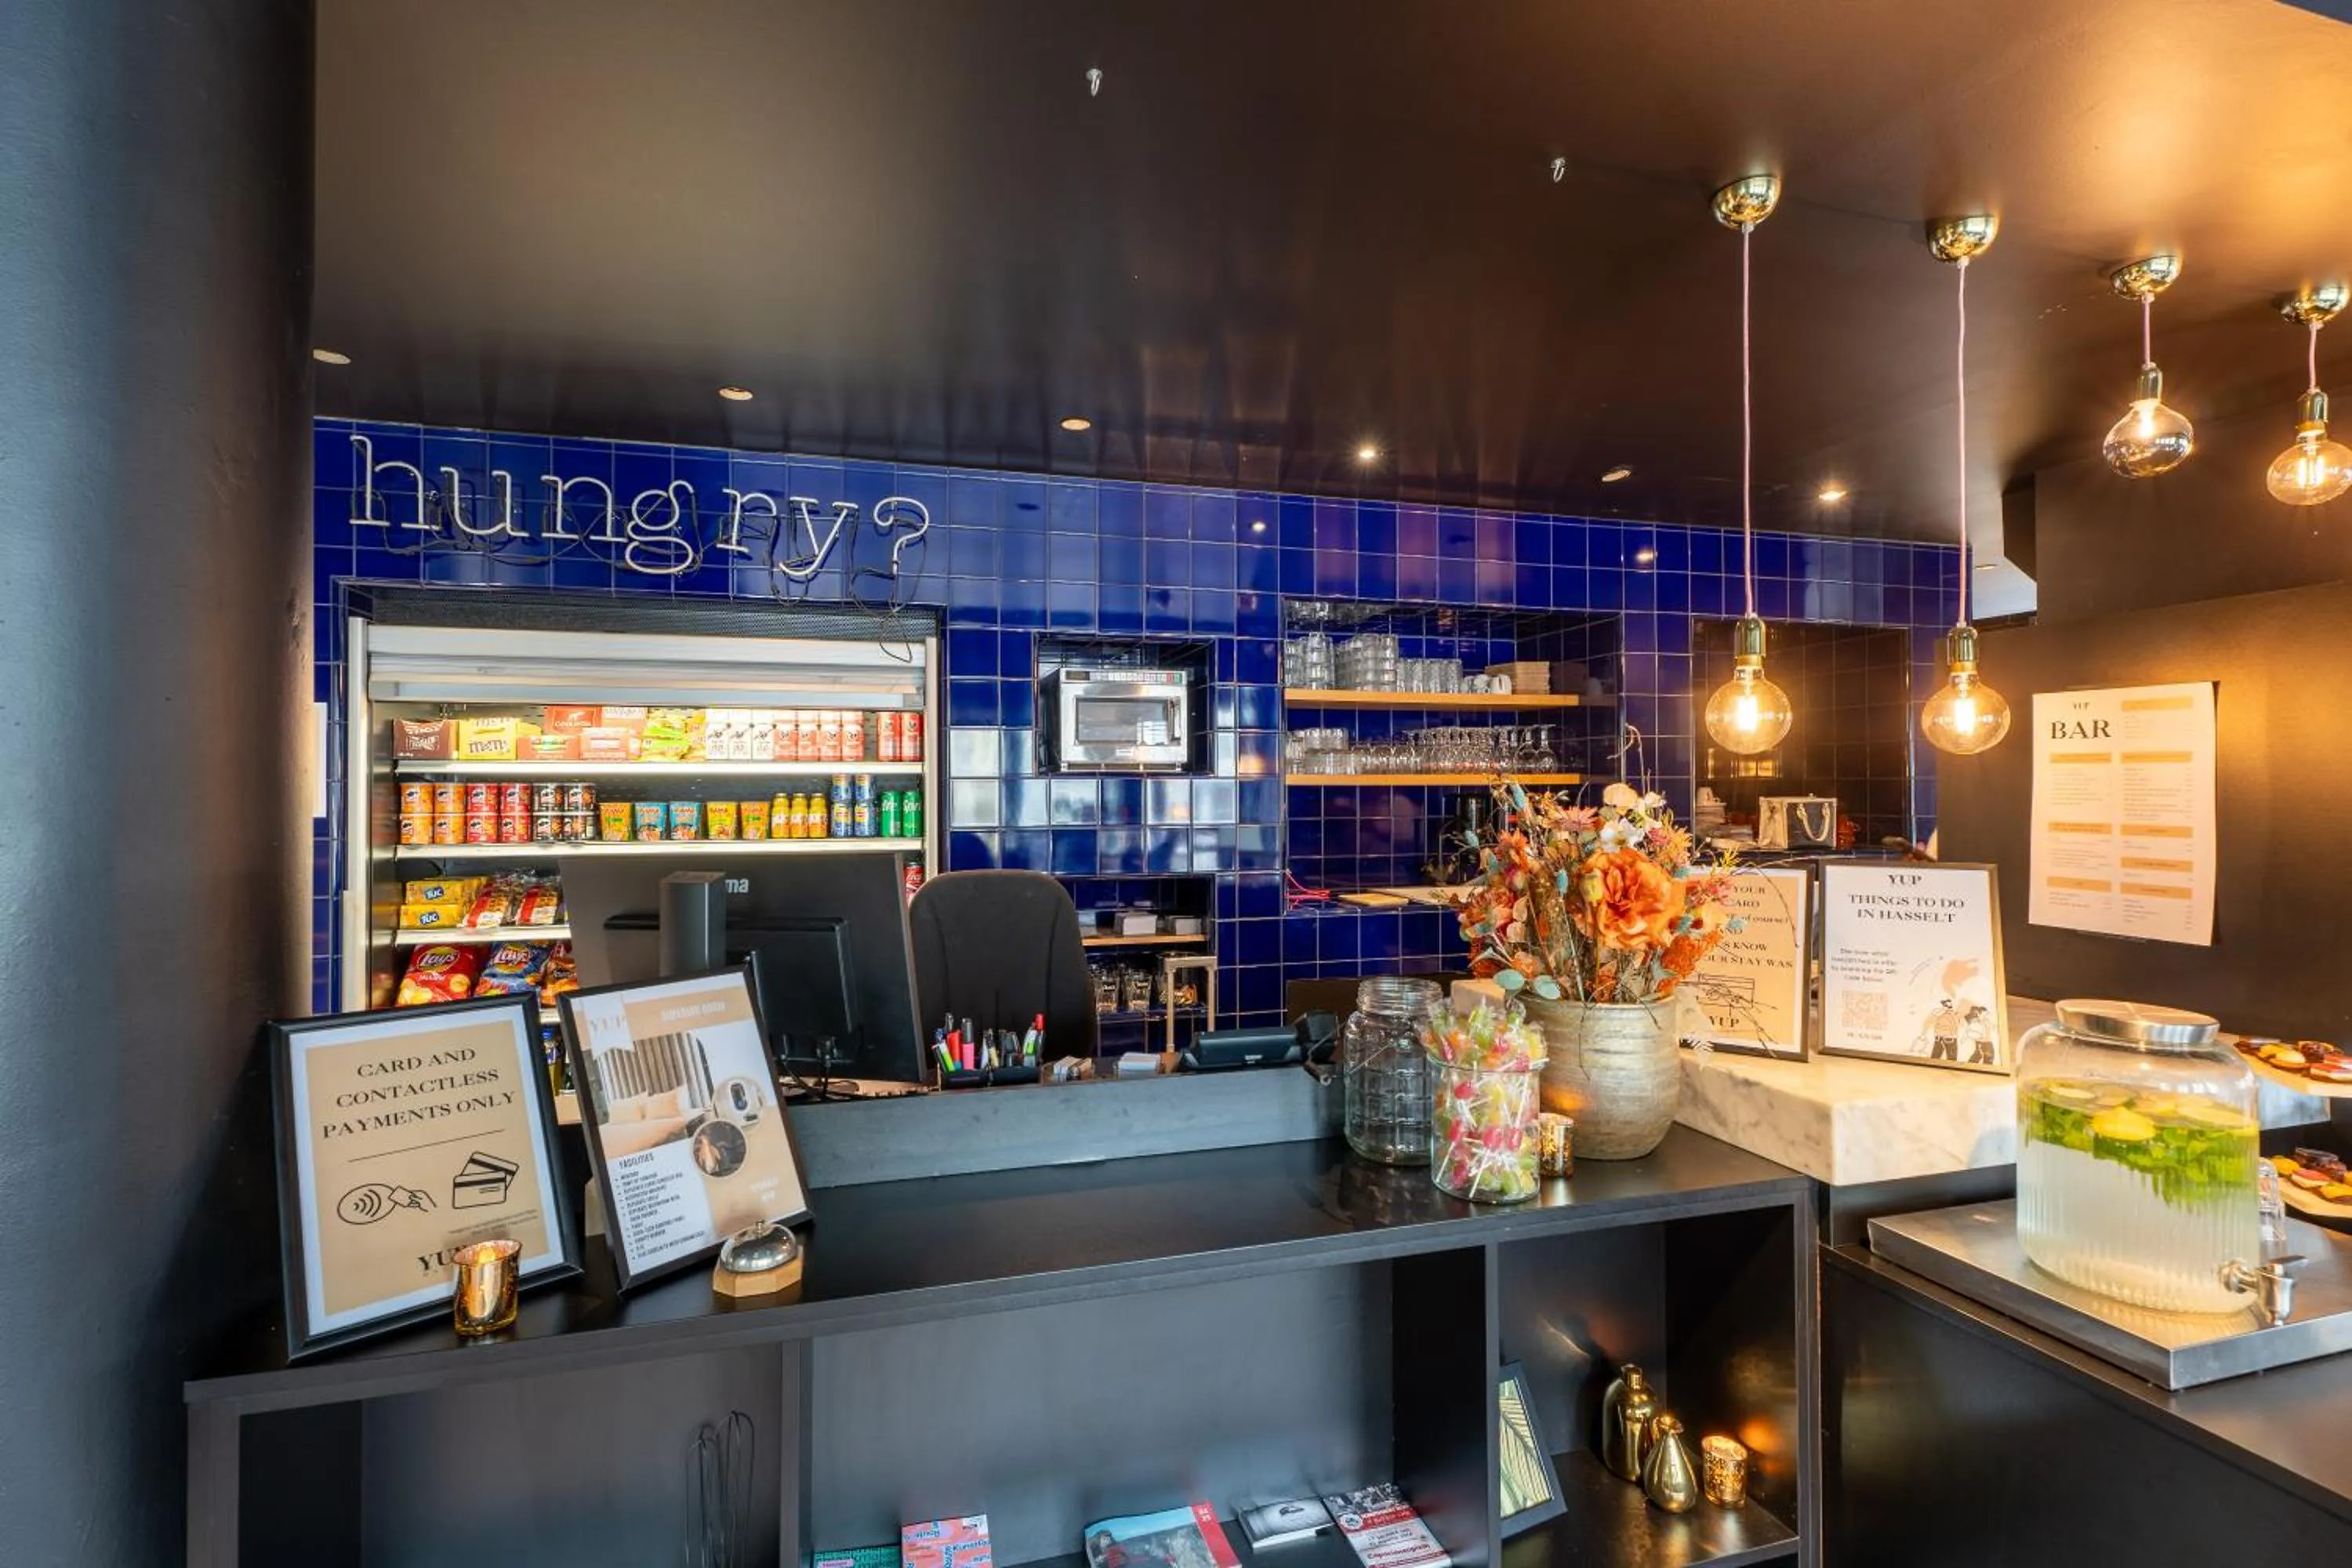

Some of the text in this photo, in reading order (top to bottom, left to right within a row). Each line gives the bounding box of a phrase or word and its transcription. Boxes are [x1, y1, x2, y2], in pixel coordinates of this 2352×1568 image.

[2051, 719, 2112, 739] BAR
[1888, 874, 1922, 886] YUP
[1733, 886, 1766, 895] YOUR
[1735, 899, 1760, 908] ARD
[1848, 894, 1965, 909] THINGS TO DO
[1857, 909, 1956, 923] IN HASSELT
[1733, 941, 1768, 952] KNOW
[1730, 954, 1762, 966] STAY
[1766, 959, 1793, 968] WAS
[590, 1014, 626, 1033] YUP
[1709, 1015, 1740, 1028] YUP
[357, 1047, 477, 1078] CARD AND
[336, 1069, 500, 1109] CONTACTLESS
[322, 1091, 516, 1139] PAYMENTS ONLY
[418, 1244, 468, 1271] YU
